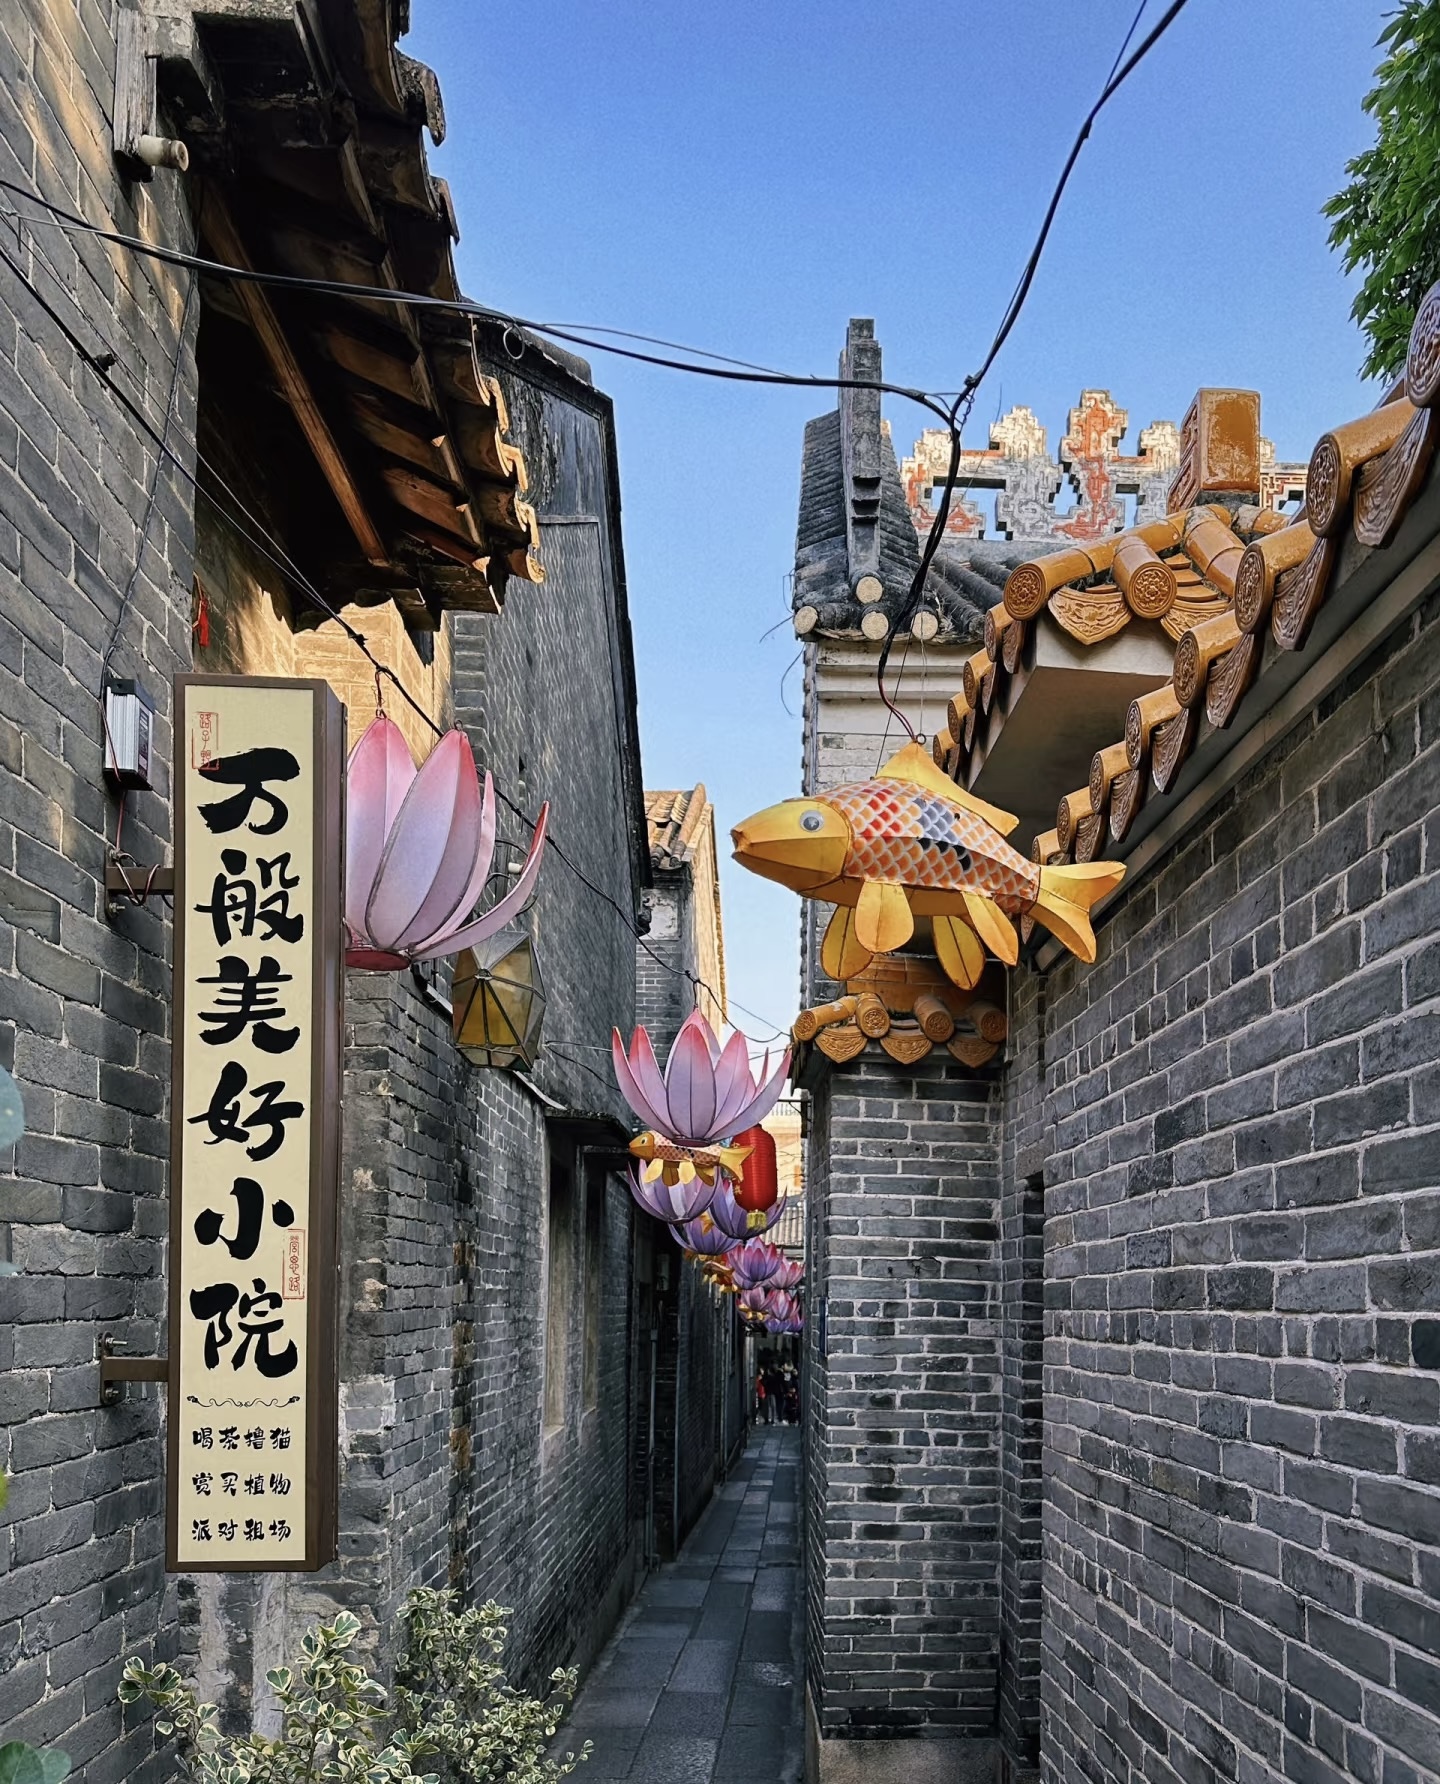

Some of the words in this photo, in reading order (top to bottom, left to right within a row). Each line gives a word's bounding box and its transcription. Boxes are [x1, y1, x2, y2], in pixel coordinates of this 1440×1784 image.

[187, 746, 306, 1378] 万般美好小院
[192, 1426, 292, 1451] 喝茶撸猫
[191, 1471, 292, 1497] 赏买植物
[191, 1518, 292, 1542] 派对租场
